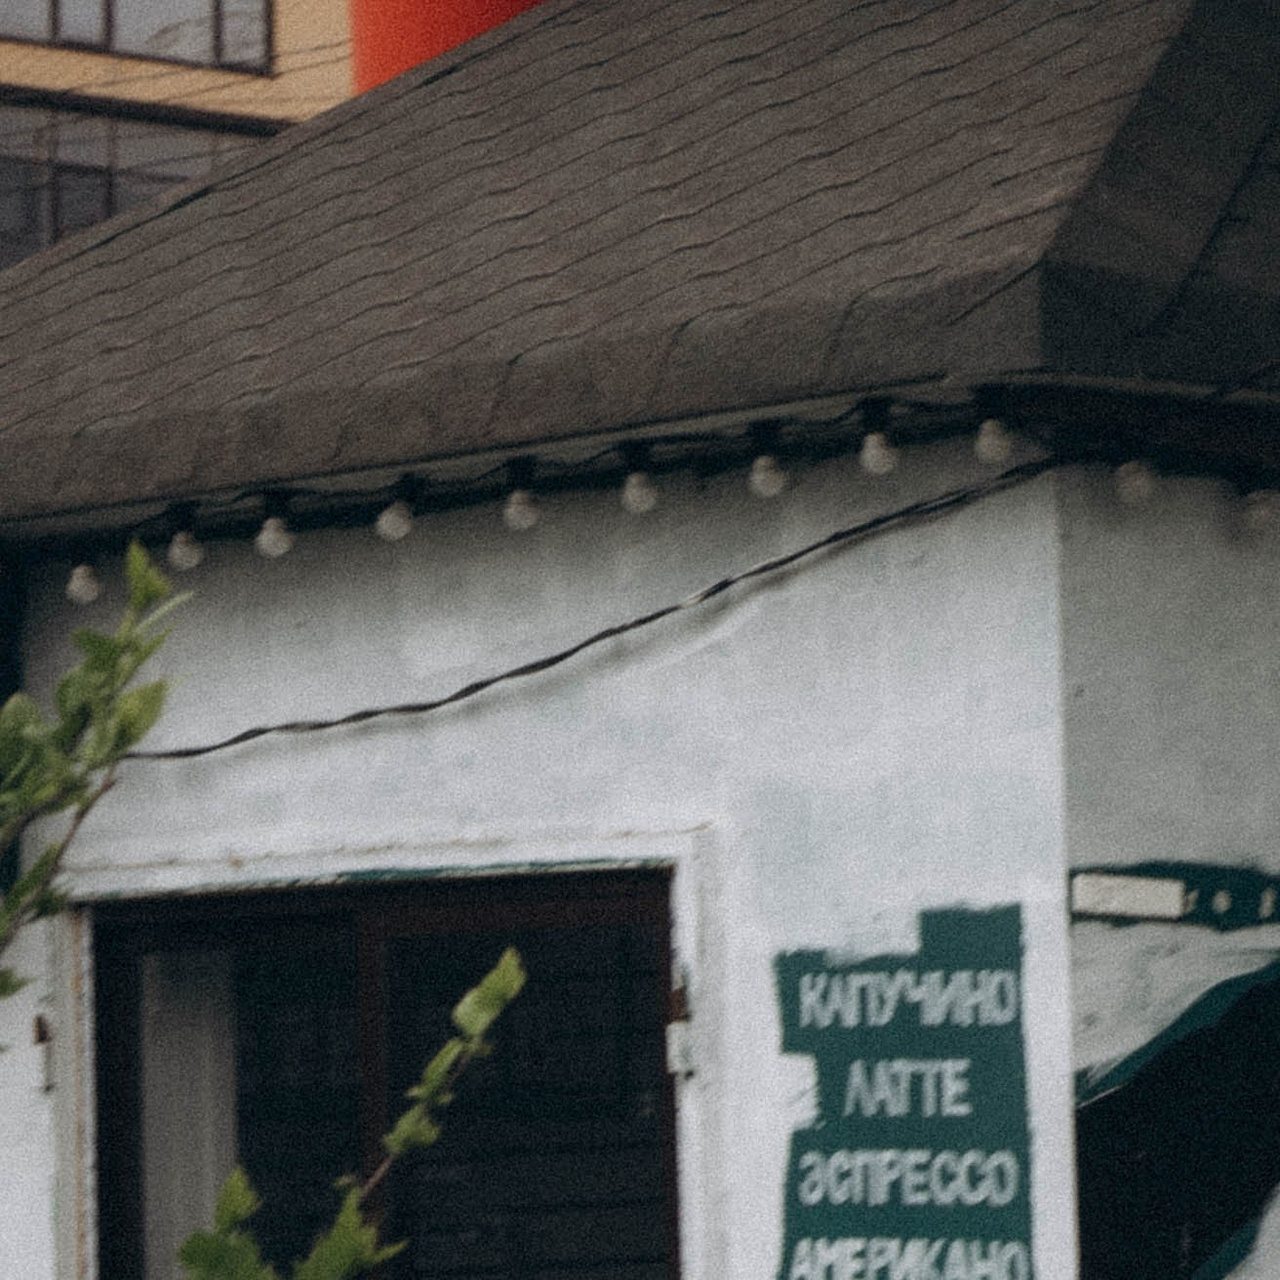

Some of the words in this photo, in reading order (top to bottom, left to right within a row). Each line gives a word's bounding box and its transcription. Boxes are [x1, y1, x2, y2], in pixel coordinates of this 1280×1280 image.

[800, 969, 1019, 1027] КАПУЧИНО
[844, 1058, 973, 1117] ЛАТТЕ
[800, 1148, 1019, 1207] ЭСПРЕССО
